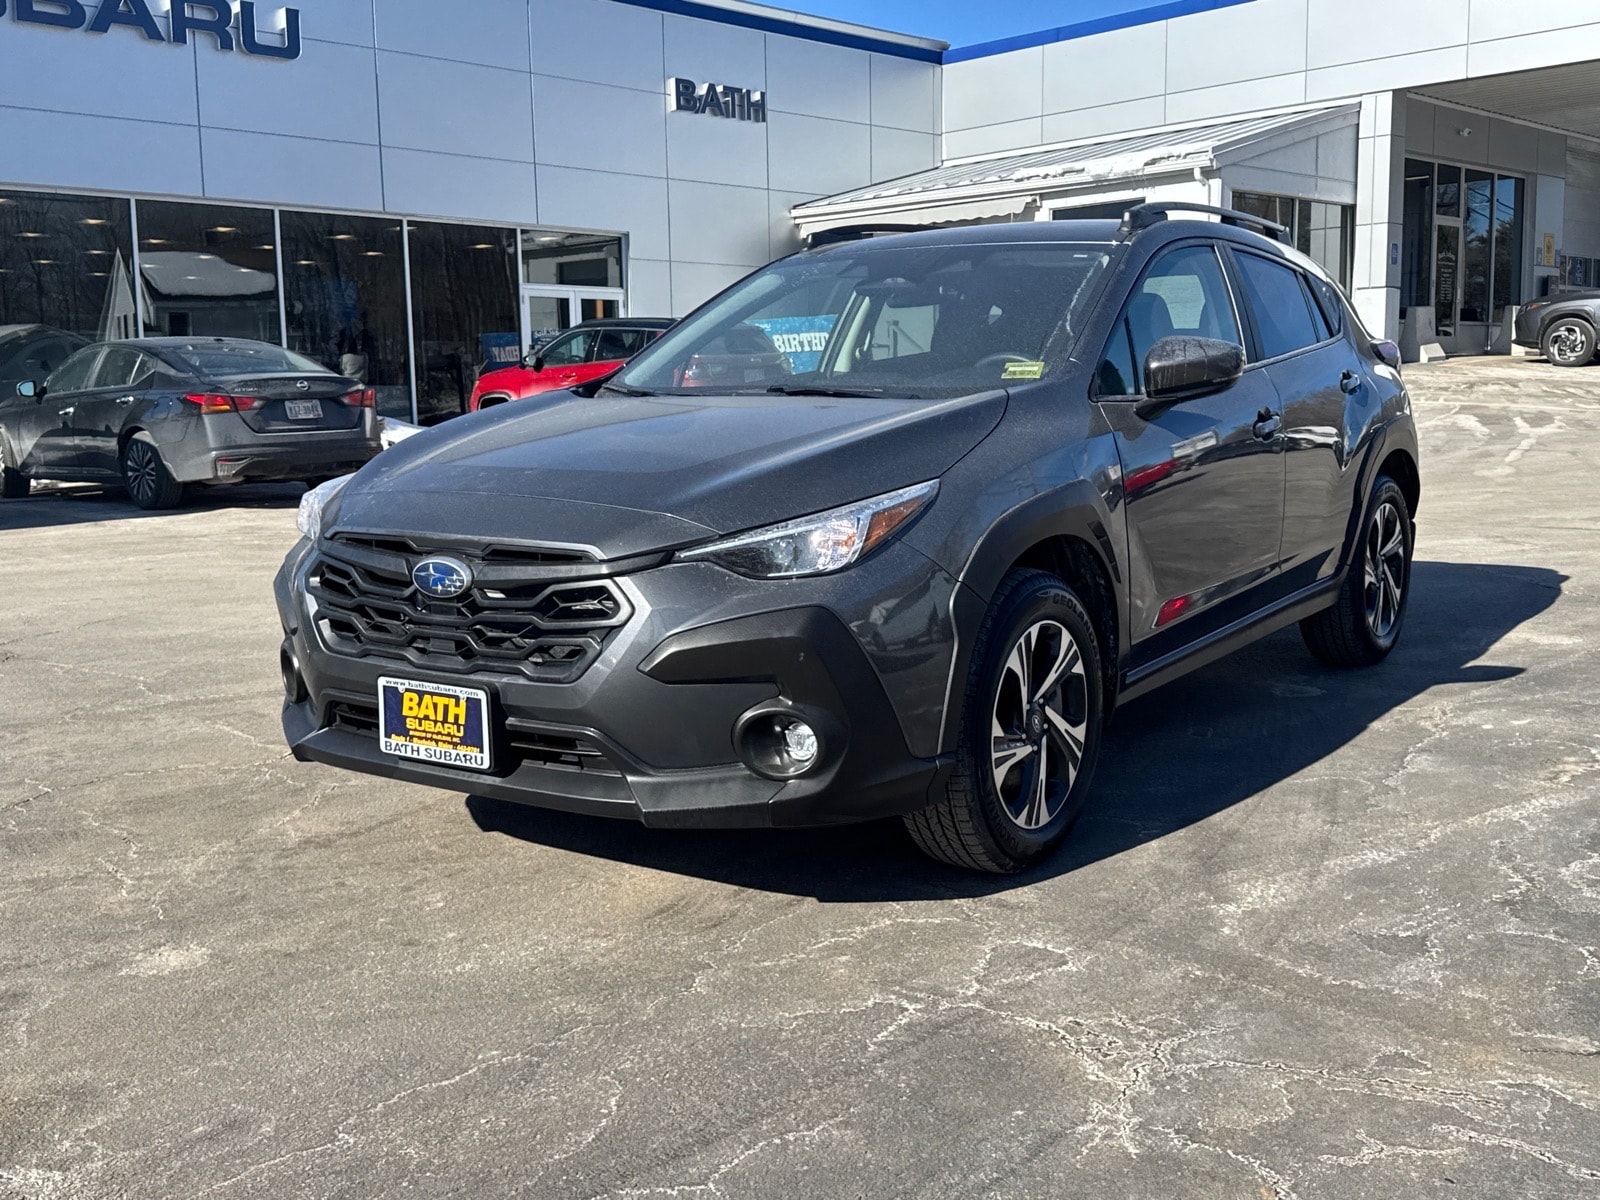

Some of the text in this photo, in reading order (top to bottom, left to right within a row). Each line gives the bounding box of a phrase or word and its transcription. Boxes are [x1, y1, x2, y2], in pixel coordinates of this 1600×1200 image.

[671, 77, 766, 122] BATH
[402, 691, 467, 725] BATH
[405, 717, 465, 737] SUBARU
[384, 740, 484, 767] BATH SUBARU
